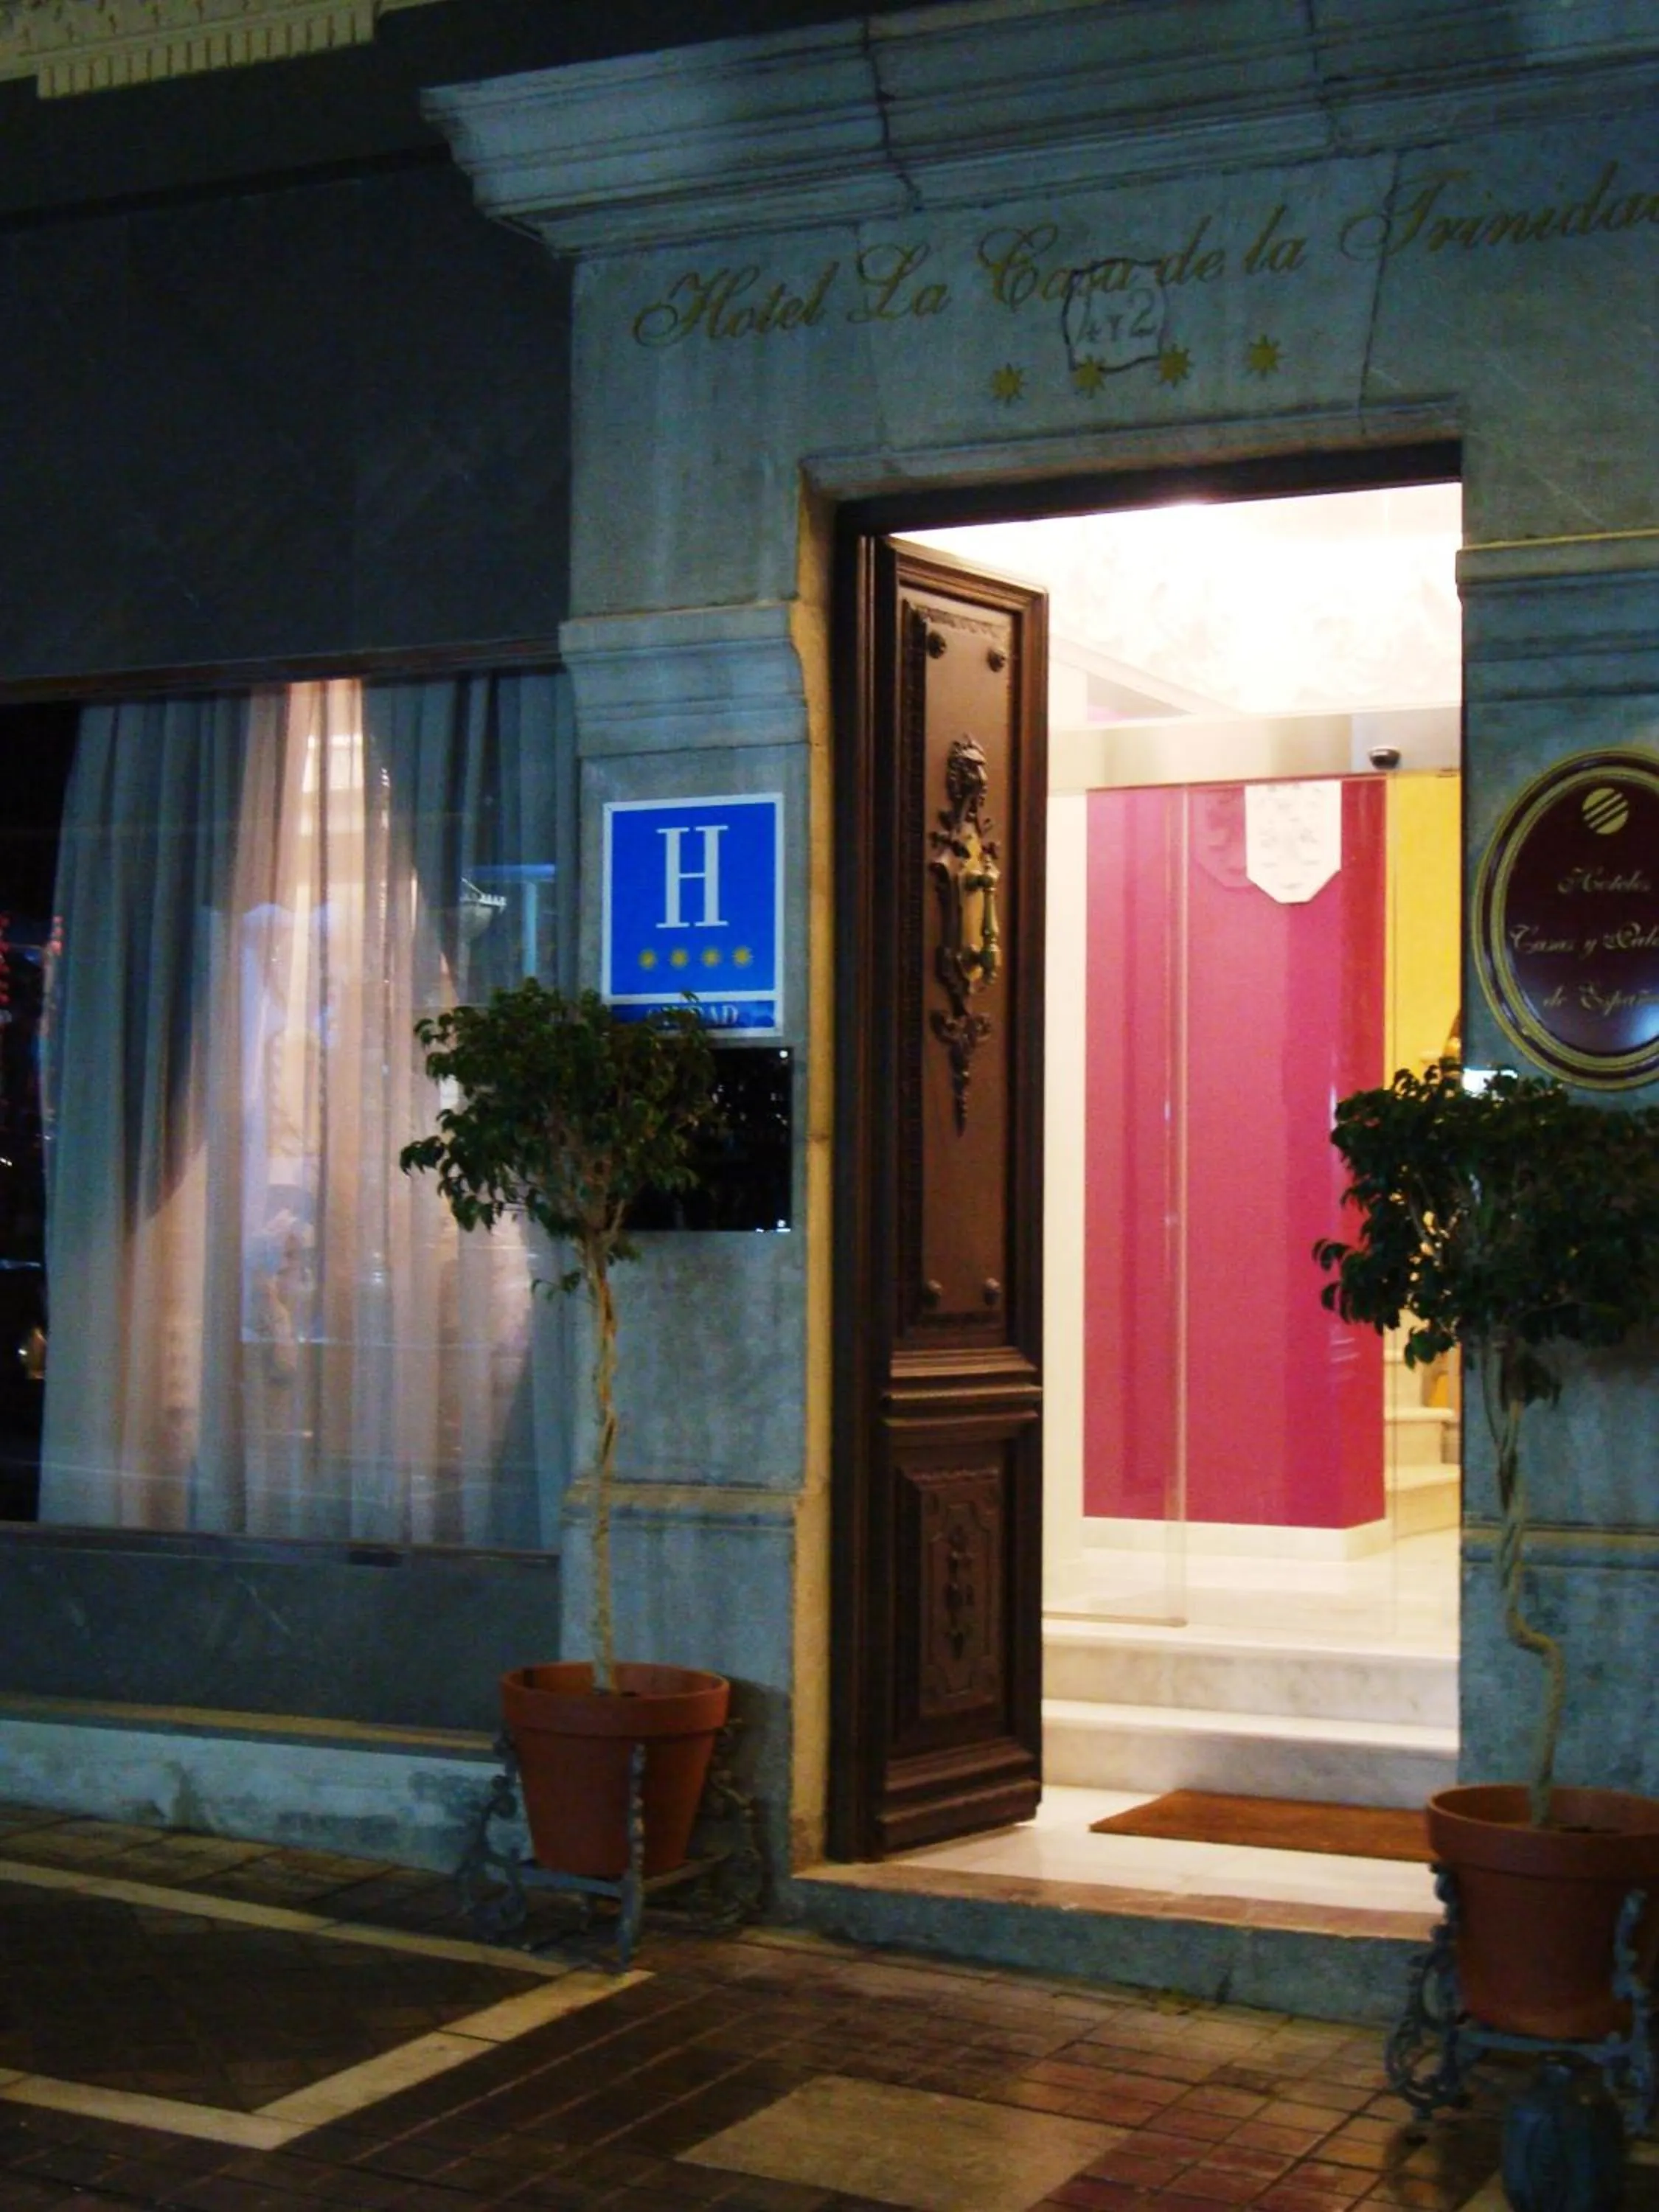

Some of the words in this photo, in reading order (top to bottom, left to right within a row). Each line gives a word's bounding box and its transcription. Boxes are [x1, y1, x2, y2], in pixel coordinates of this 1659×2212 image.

[632, 260, 840, 347] Hotel
[846, 241, 951, 324] La
[1155, 215, 1225, 286] de
[1242, 204, 1308, 275] la
[655, 825, 728, 929] H
[1543, 985, 1568, 1007] de
